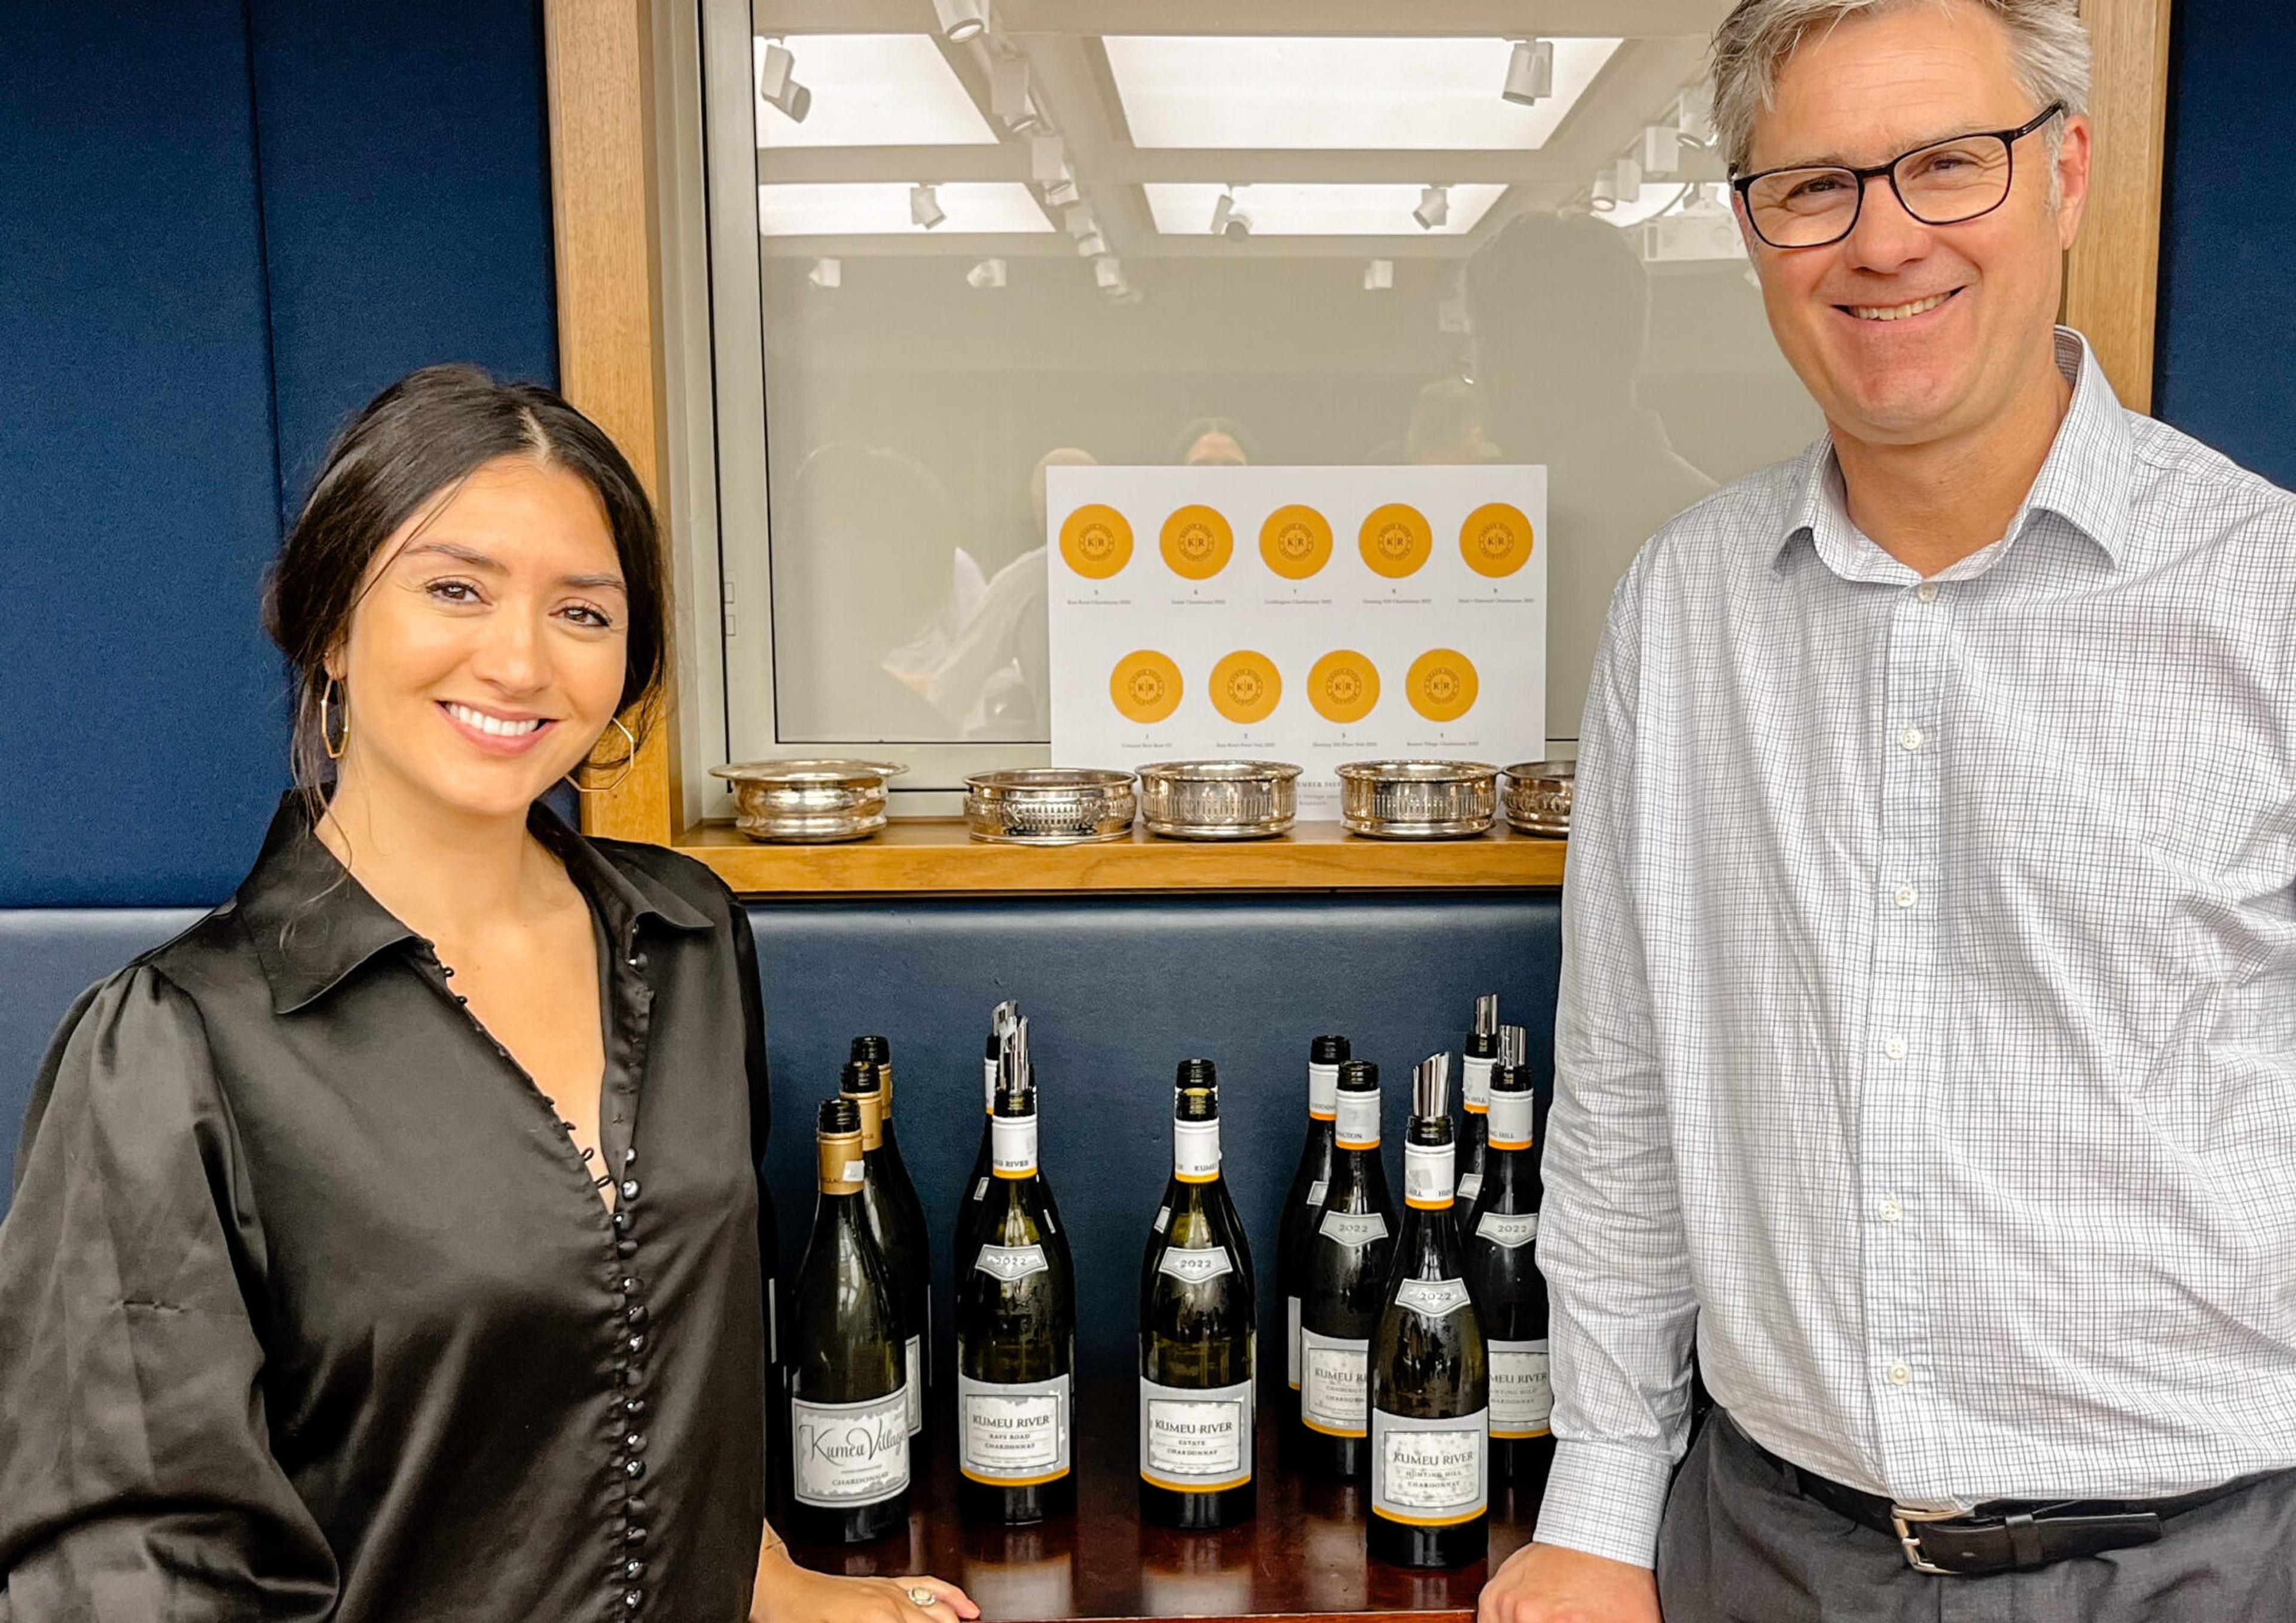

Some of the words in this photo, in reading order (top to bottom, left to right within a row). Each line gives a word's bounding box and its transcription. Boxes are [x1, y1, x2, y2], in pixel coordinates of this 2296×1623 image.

[1498, 1225, 1529, 1233] 2022
[996, 1257, 1026, 1265] 2022
[1180, 1260, 1211, 1268] 2022
[1419, 1292, 1451, 1301] 2022
[1315, 1368, 1352, 1382] KUMEU
[973, 1414, 1013, 1428] KUMEU
[1016, 1415, 1049, 1428] RIVER
[1155, 1419, 1196, 1434] KUMEU
[1199, 1422, 1232, 1434] RIVER
[1394, 1451, 1439, 1466] KUMEU
[1443, 1451, 1473, 1465] RIVER
[832, 1472, 889, 1485] CHARDONNAY
